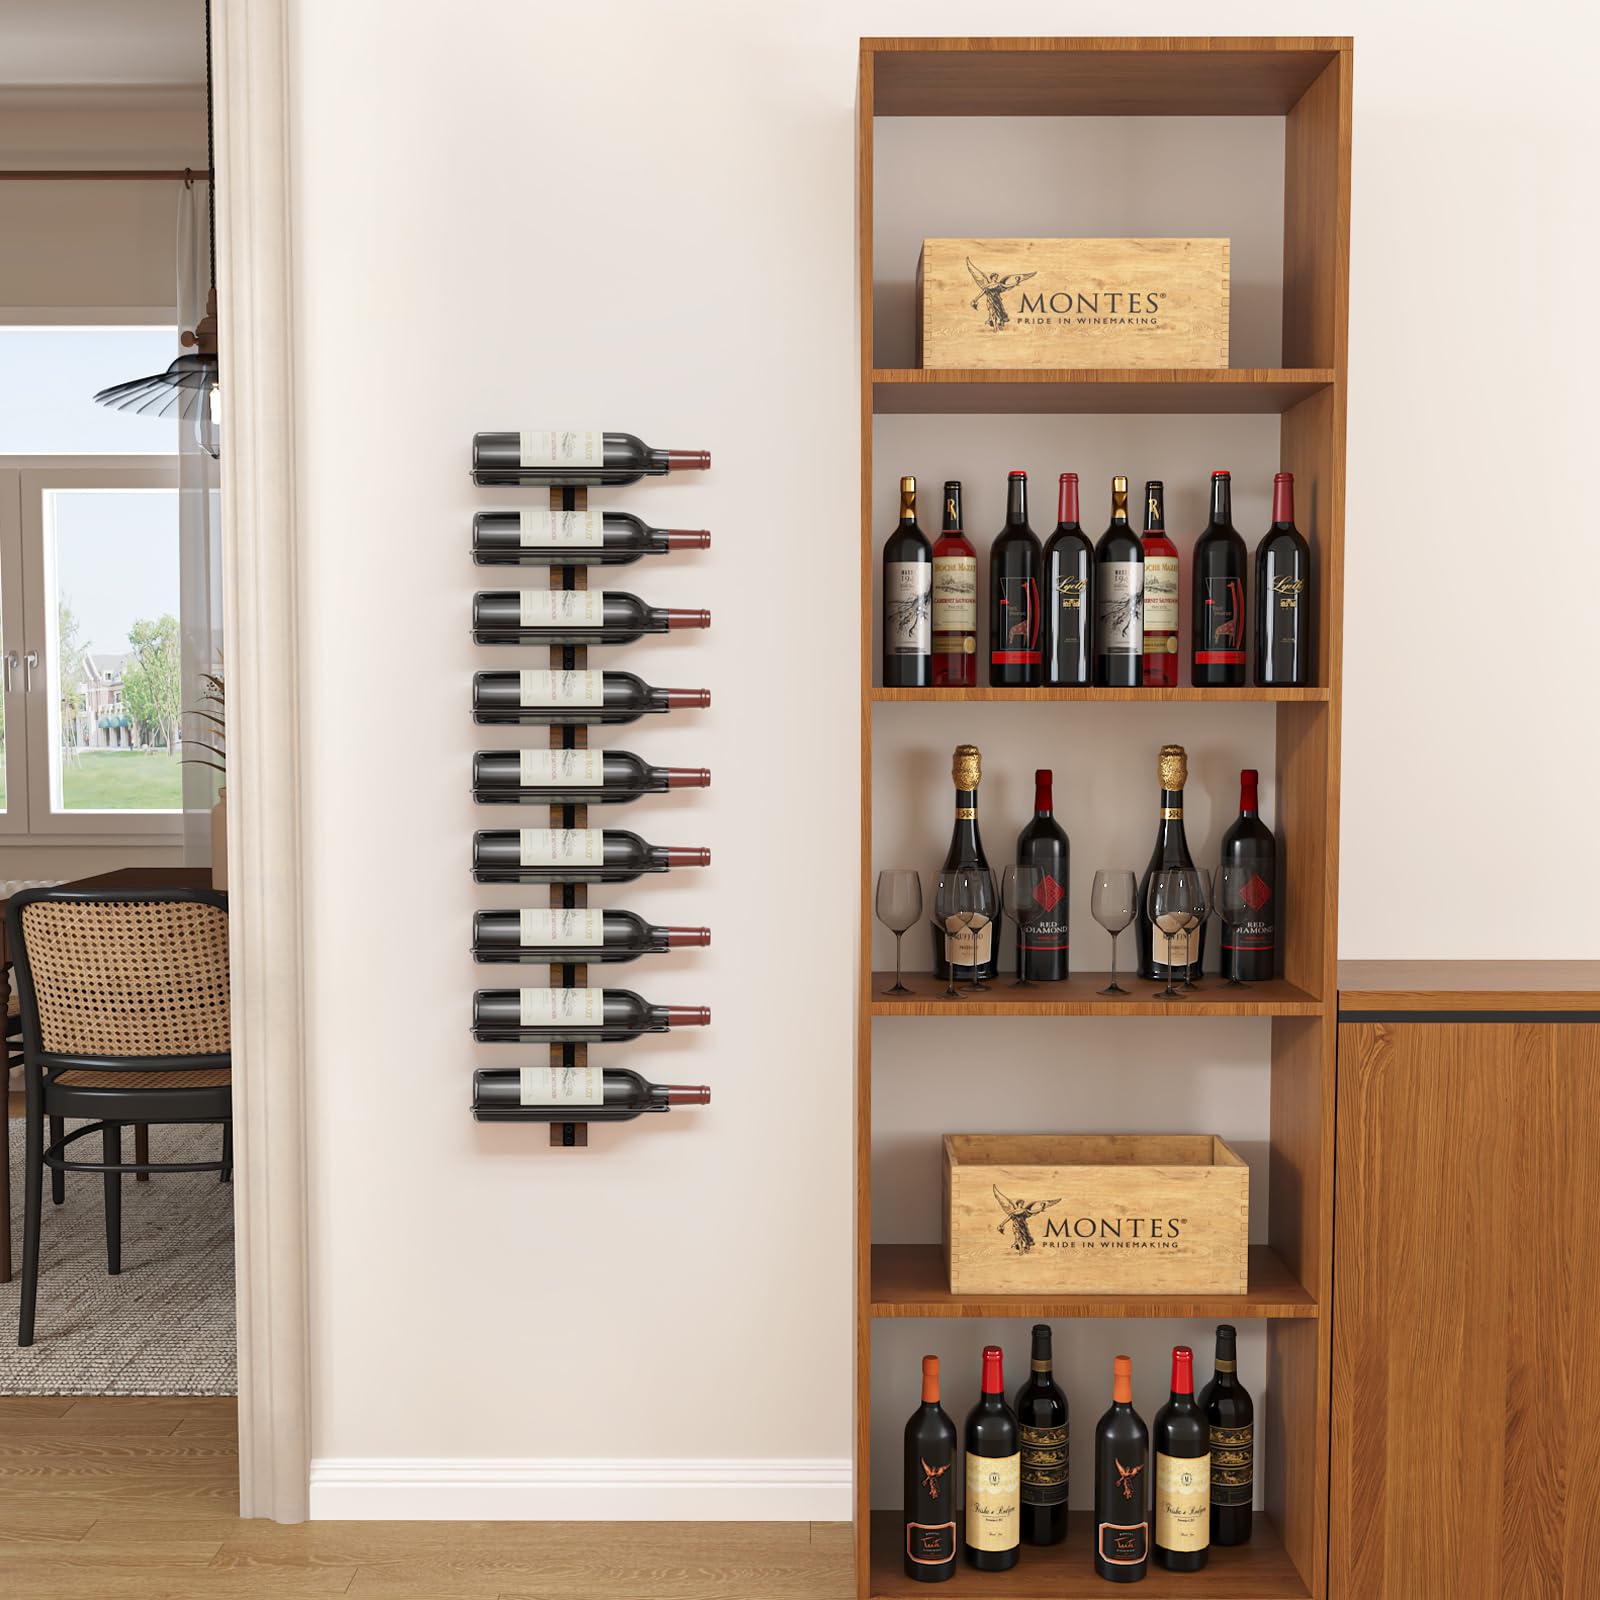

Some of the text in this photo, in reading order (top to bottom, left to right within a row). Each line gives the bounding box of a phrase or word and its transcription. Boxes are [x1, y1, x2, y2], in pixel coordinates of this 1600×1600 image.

[1016, 317, 1158, 325] PRIDE IN WINEMAKING
[1025, 925, 1068, 934] DIAMOND
[1042, 1241, 1179, 1249] PRIDE IN WINEMAKING
